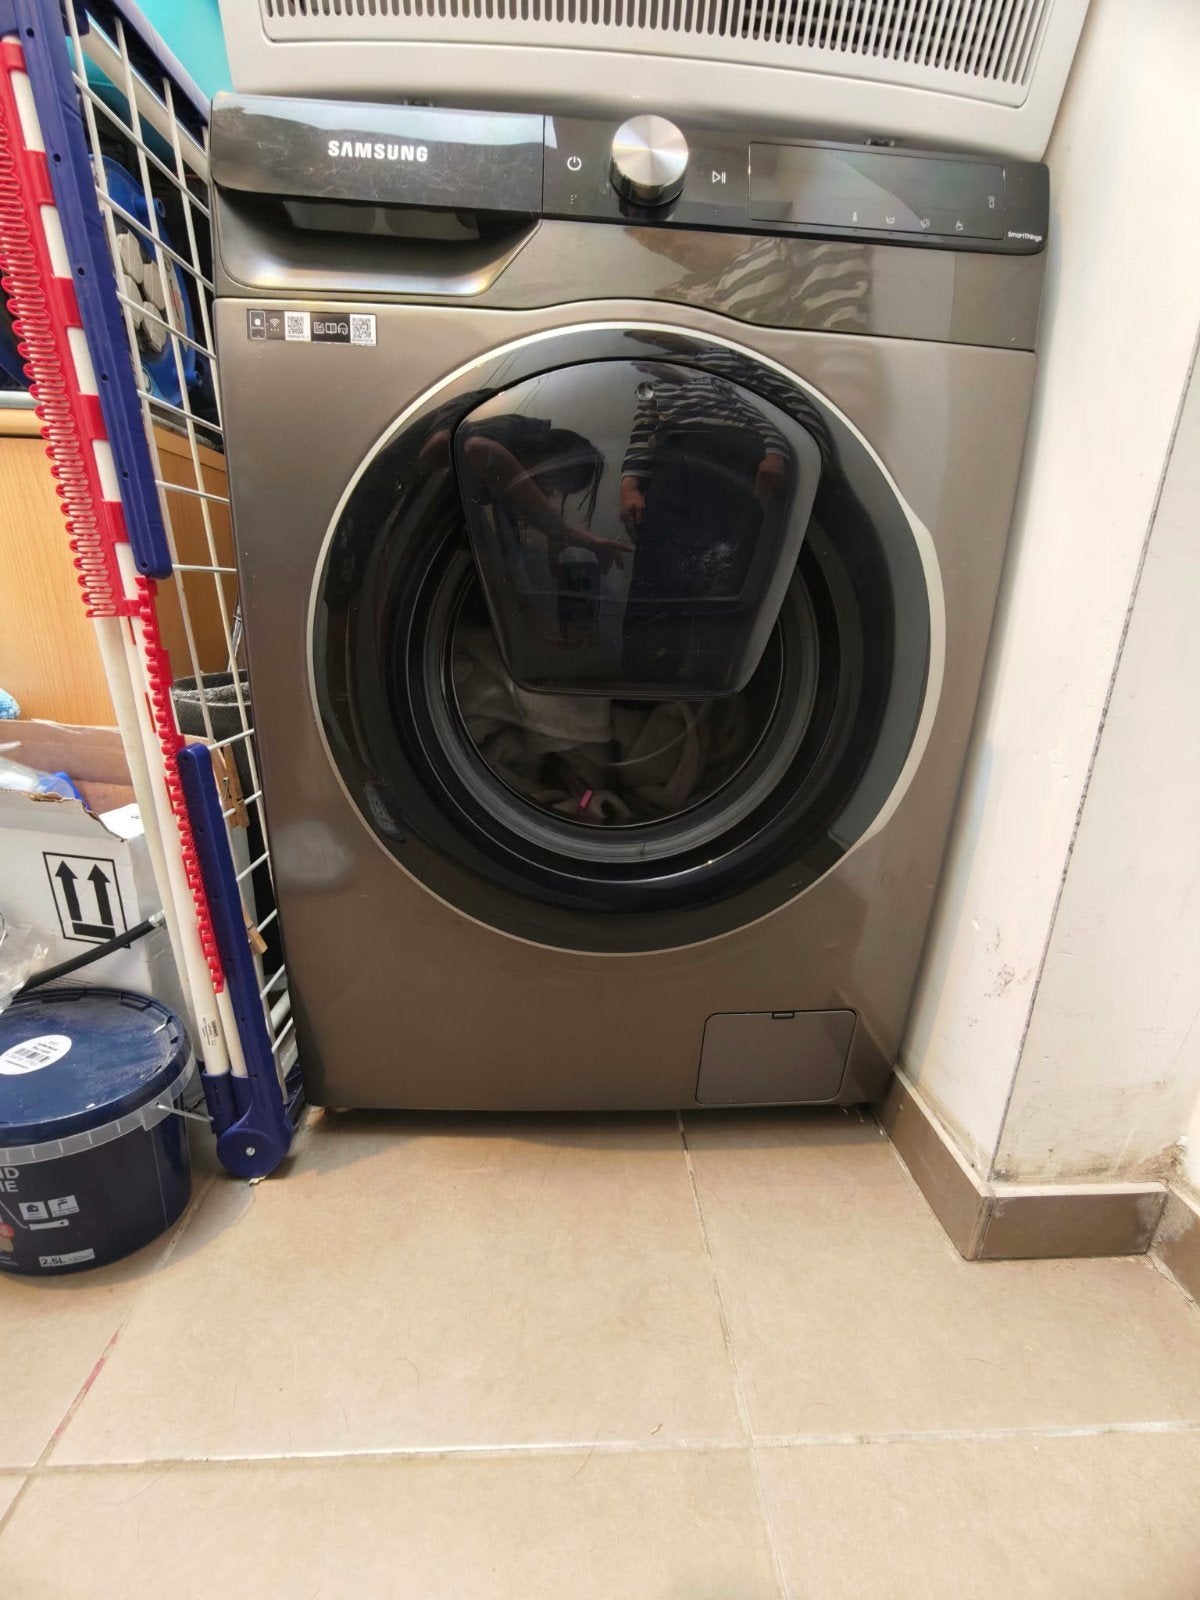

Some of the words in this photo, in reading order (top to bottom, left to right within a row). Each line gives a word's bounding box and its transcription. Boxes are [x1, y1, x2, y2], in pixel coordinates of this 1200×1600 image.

[327, 140, 428, 162] SAMSUNG
[1007, 231, 1042, 242] SmartThings
[40, 1256, 66, 1267] 2,5L
